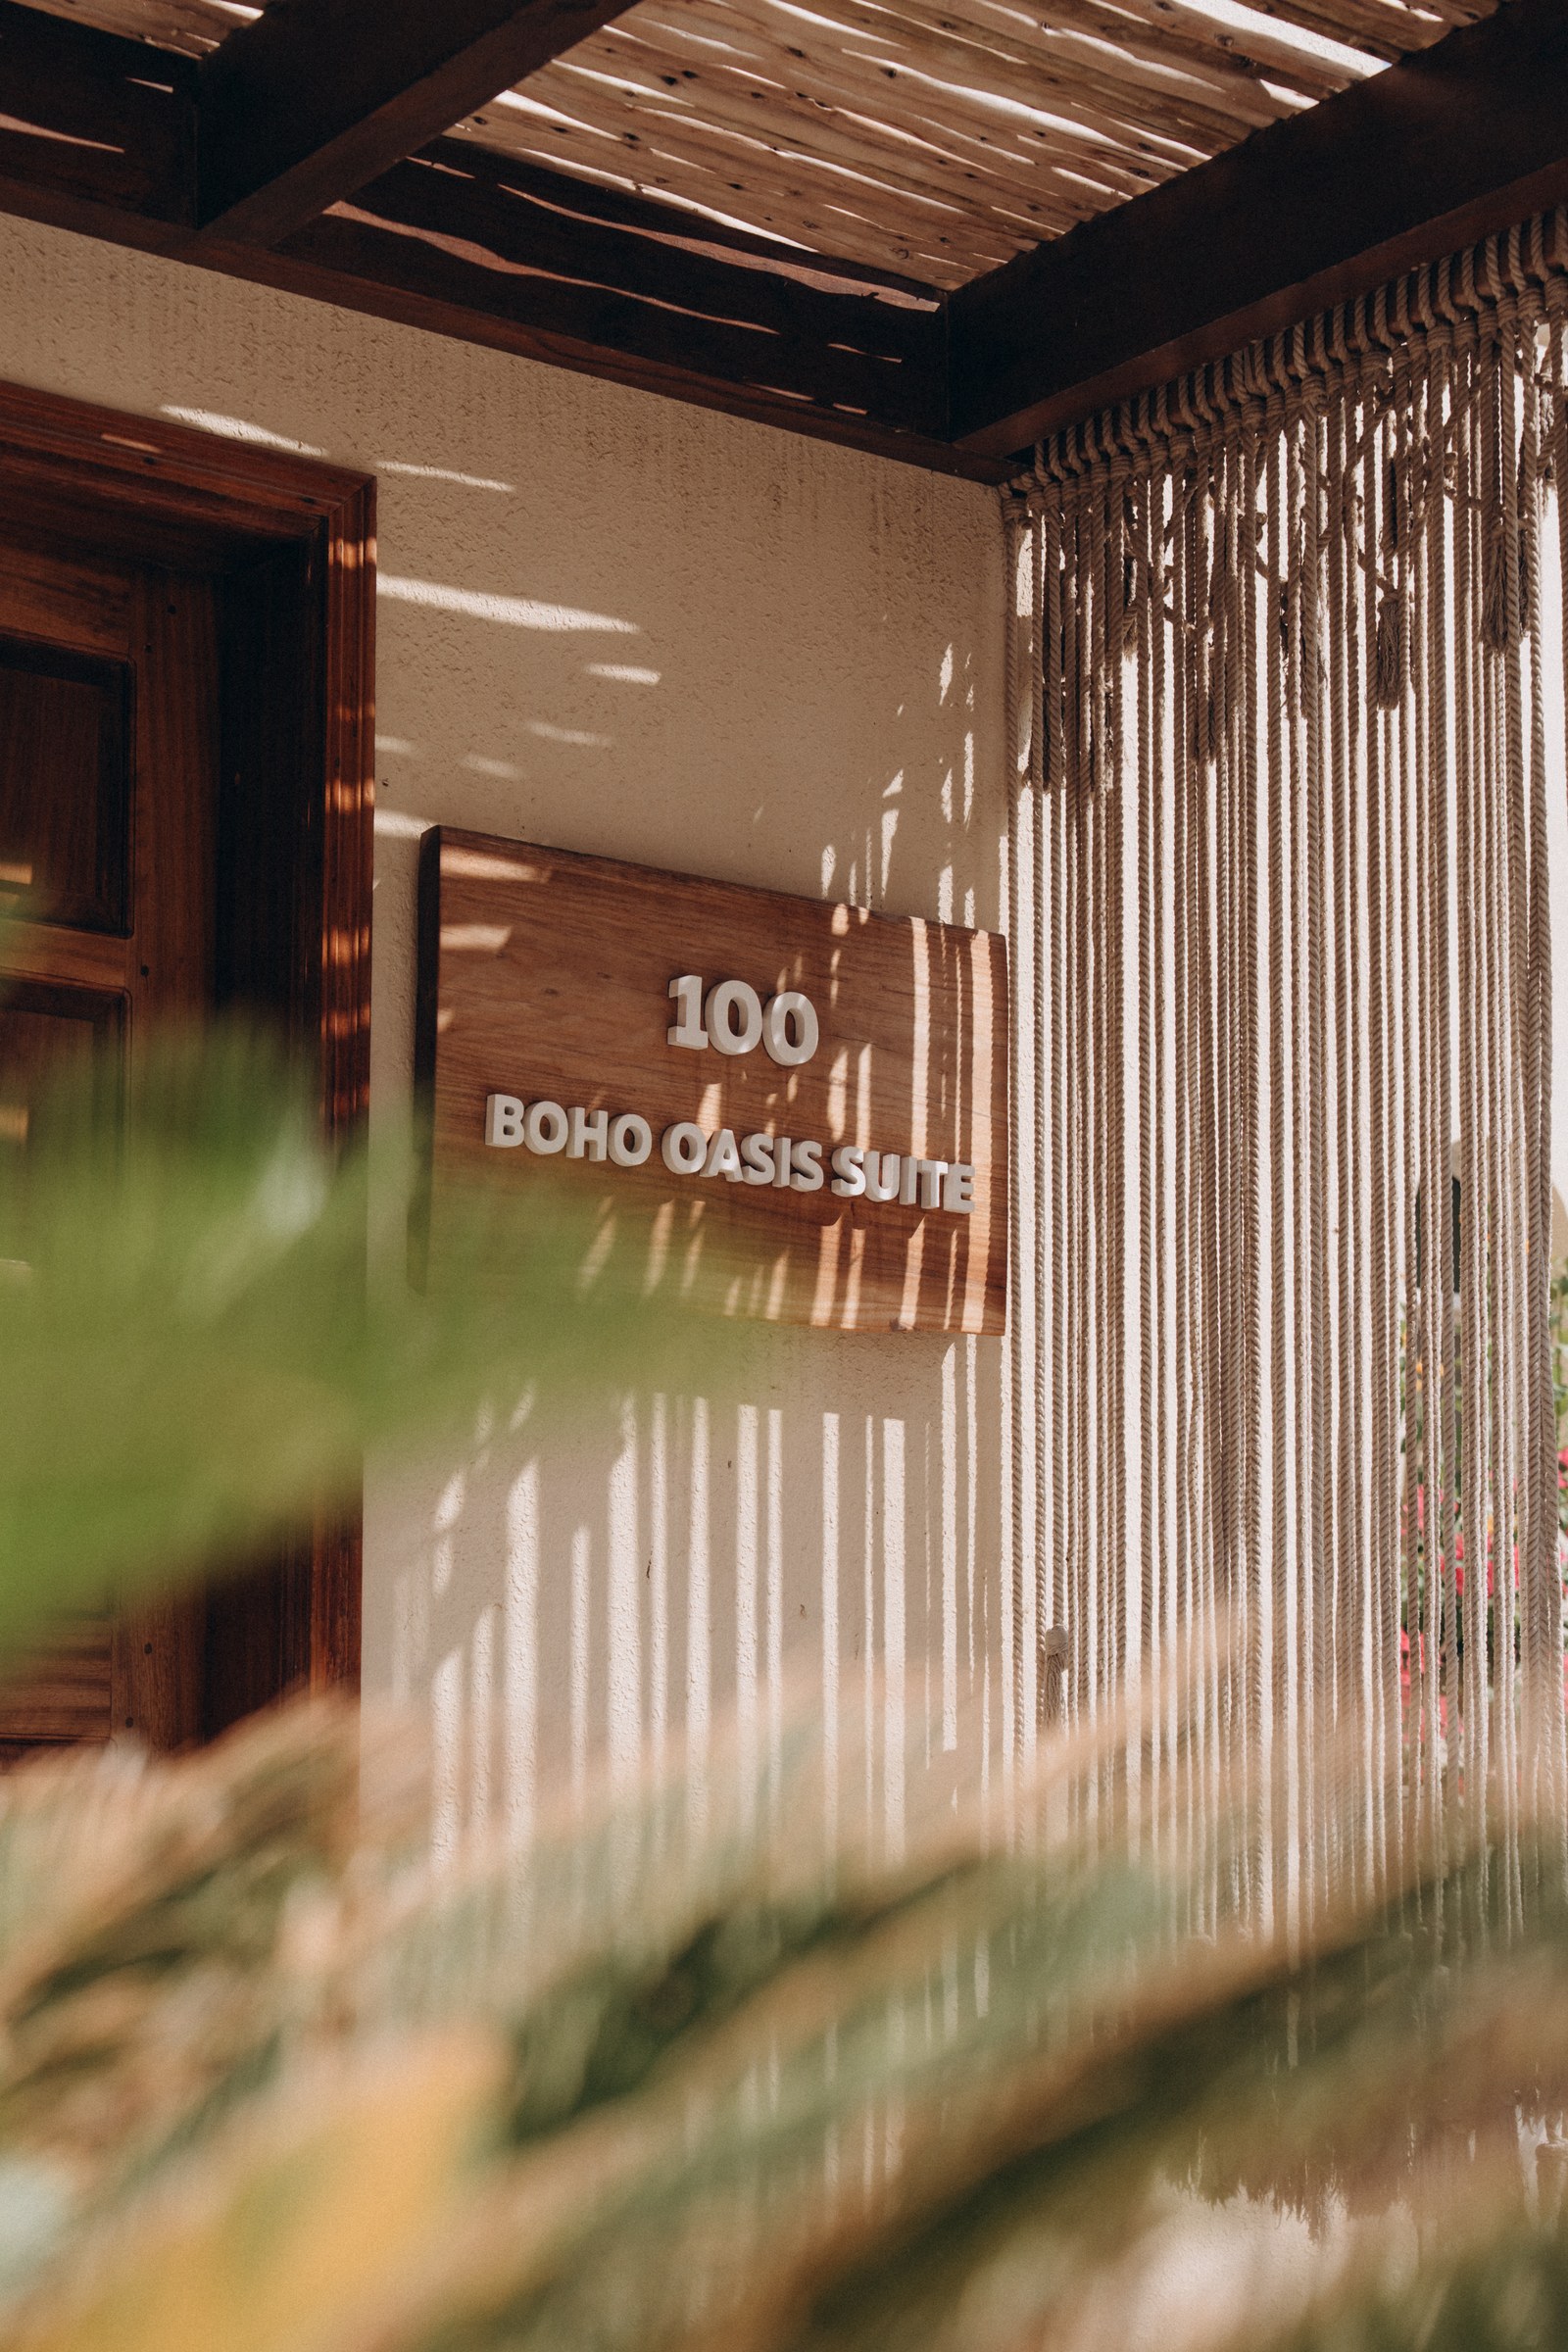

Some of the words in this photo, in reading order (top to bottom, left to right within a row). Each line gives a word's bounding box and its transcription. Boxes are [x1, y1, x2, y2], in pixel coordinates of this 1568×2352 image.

[666, 974, 819, 1067] 100
[484, 1093, 653, 1168] BOHO
[661, 1121, 824, 1193] OASIS
[830, 1146, 976, 1214] SUITE
